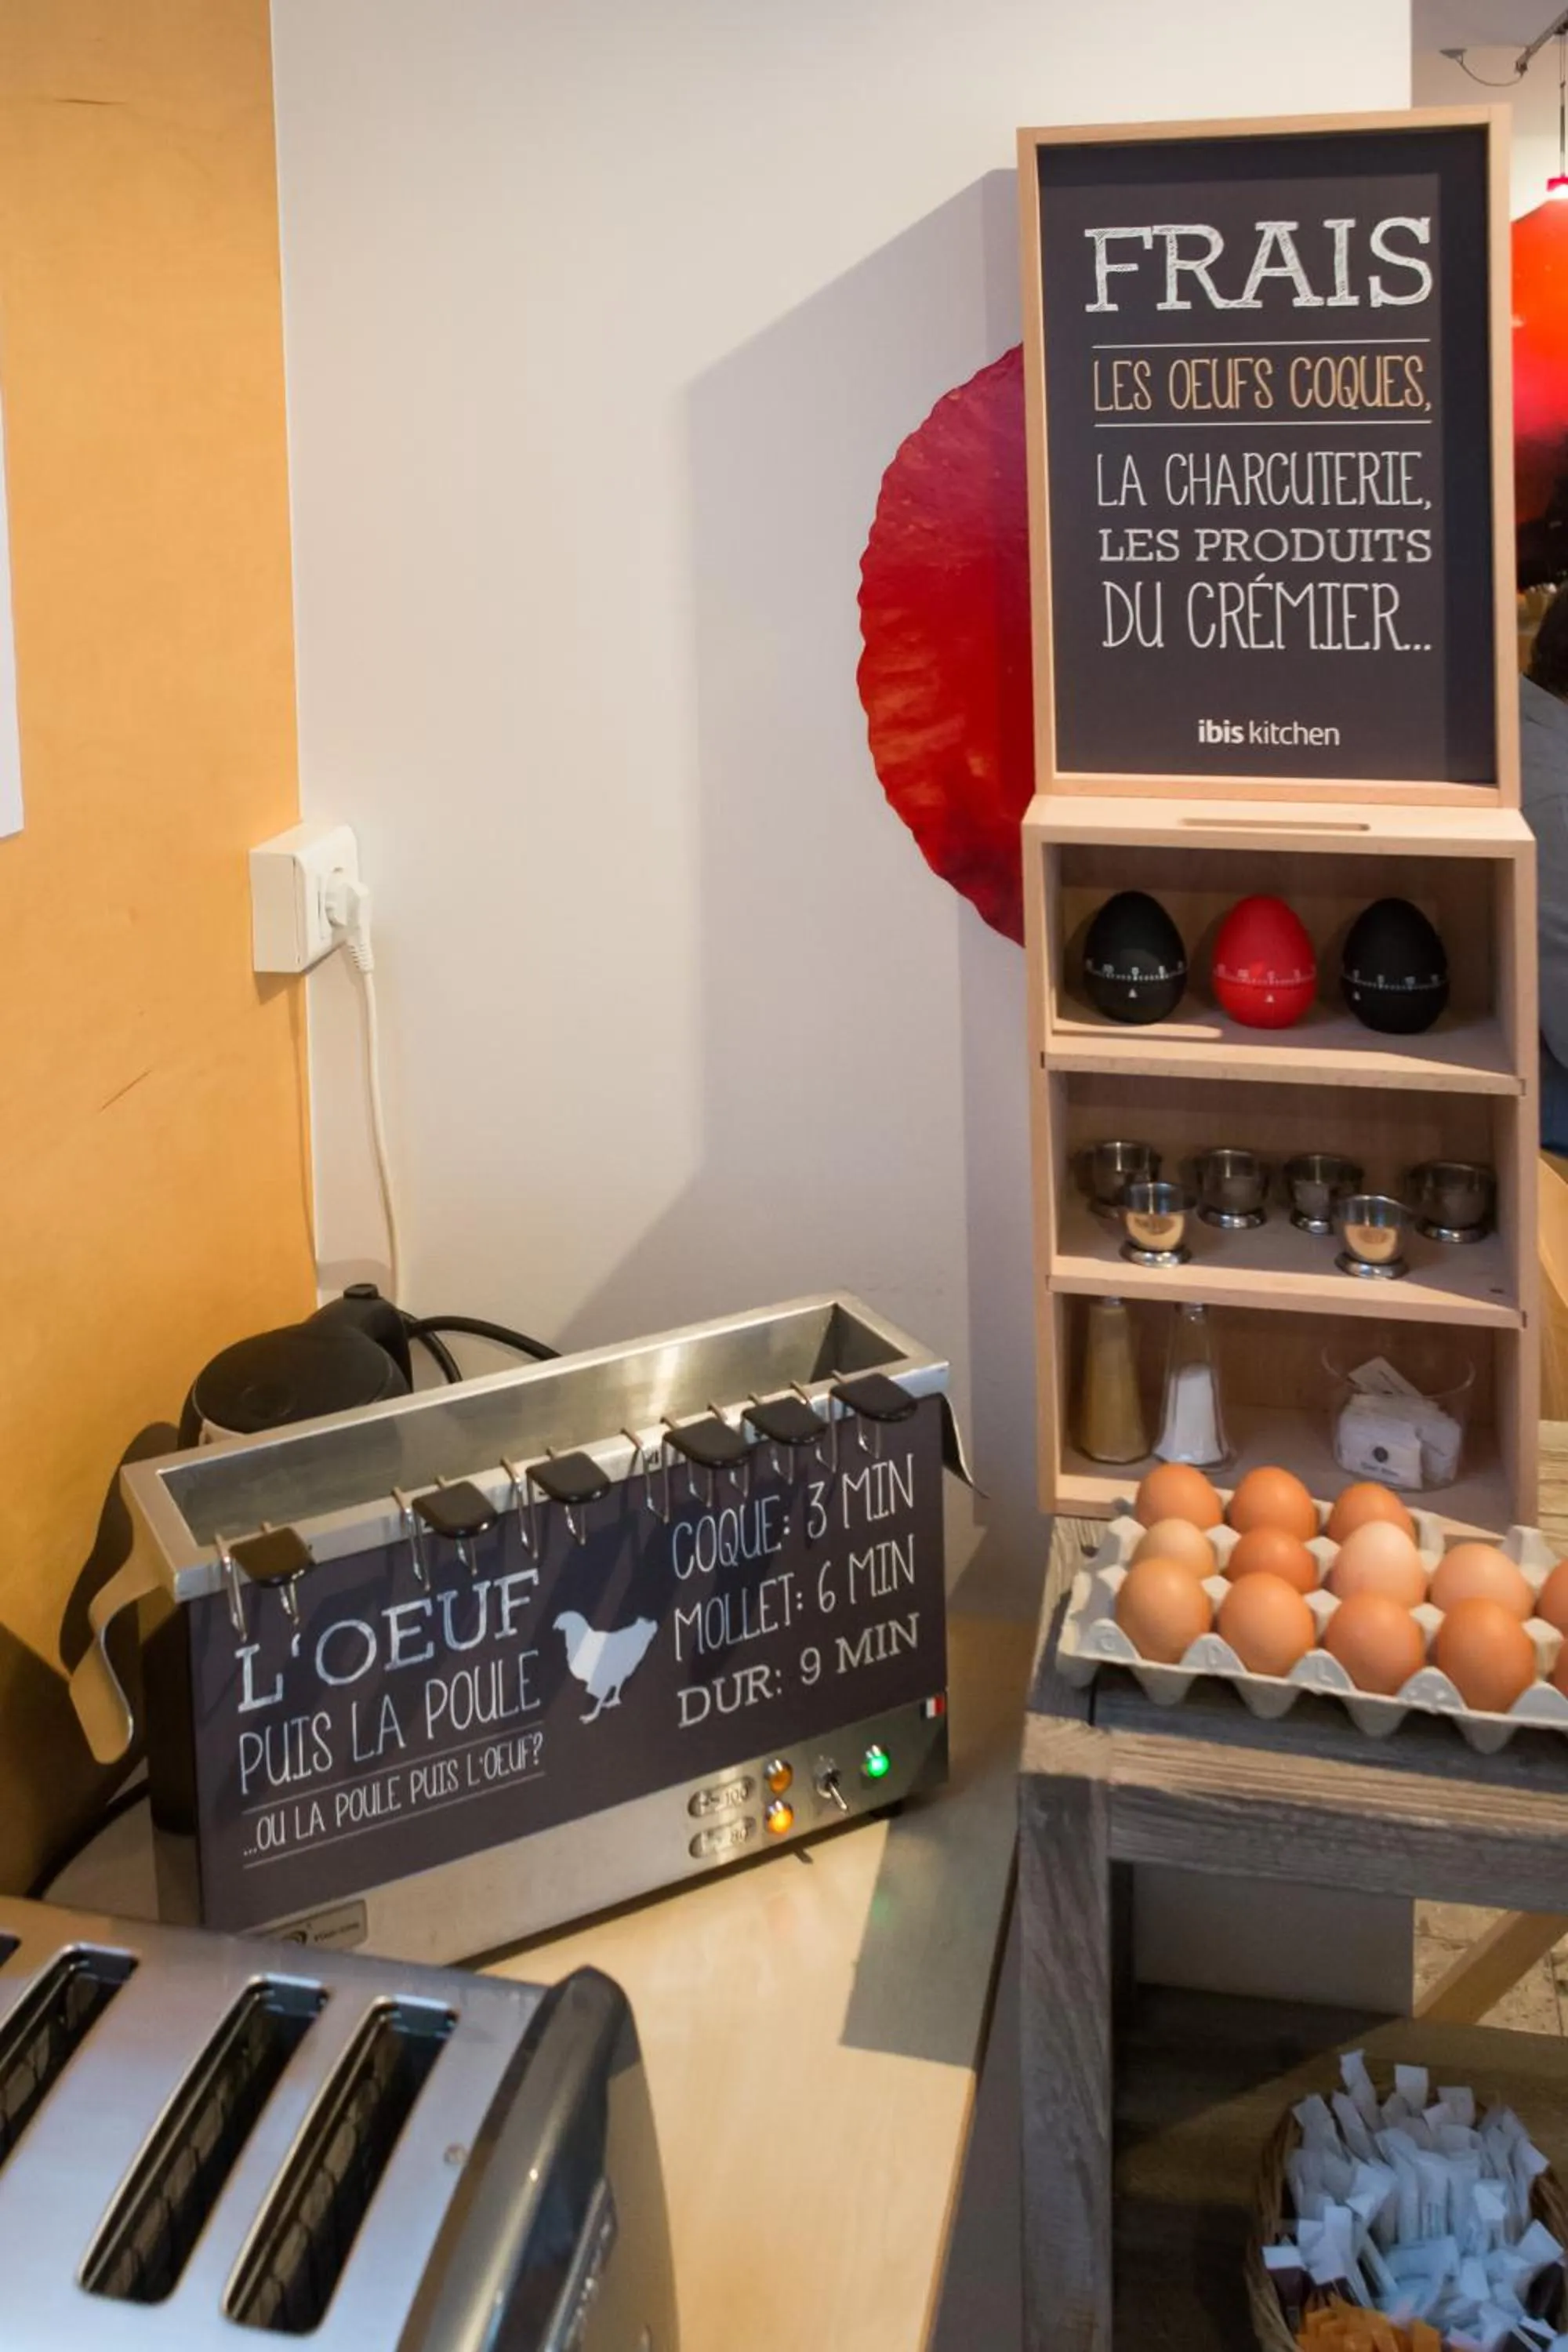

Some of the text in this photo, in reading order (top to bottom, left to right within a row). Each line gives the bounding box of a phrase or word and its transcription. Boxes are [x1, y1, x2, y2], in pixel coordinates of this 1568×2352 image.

[1084, 216, 1433, 313] FRAIS
[1094, 354, 1432, 412] LES OEUFS COQUES,
[1097, 451, 1432, 510] LA CHARCUTERIE,
[1098, 528, 1432, 563] LES PRODUITS
[1102, 581, 1164, 648] DU
[1198, 719, 1340, 746] ibis kitchen
[672, 1453, 913, 1580] COQUE: 3 MIN
[234, 1568, 539, 1714] L'OEUF
[673, 1533, 914, 1662] MOLLET: 6 MIN
[677, 1612, 920, 1728] DUR: 9 MIN
[238, 1650, 541, 1795] PUIS LA POULE
[295, 1802, 326, 1840] LA
[335, 1776, 401, 1828] POULE
[410, 1761, 459, 1798] PUIS
[466, 1731, 543, 1786] L'OEUF?
